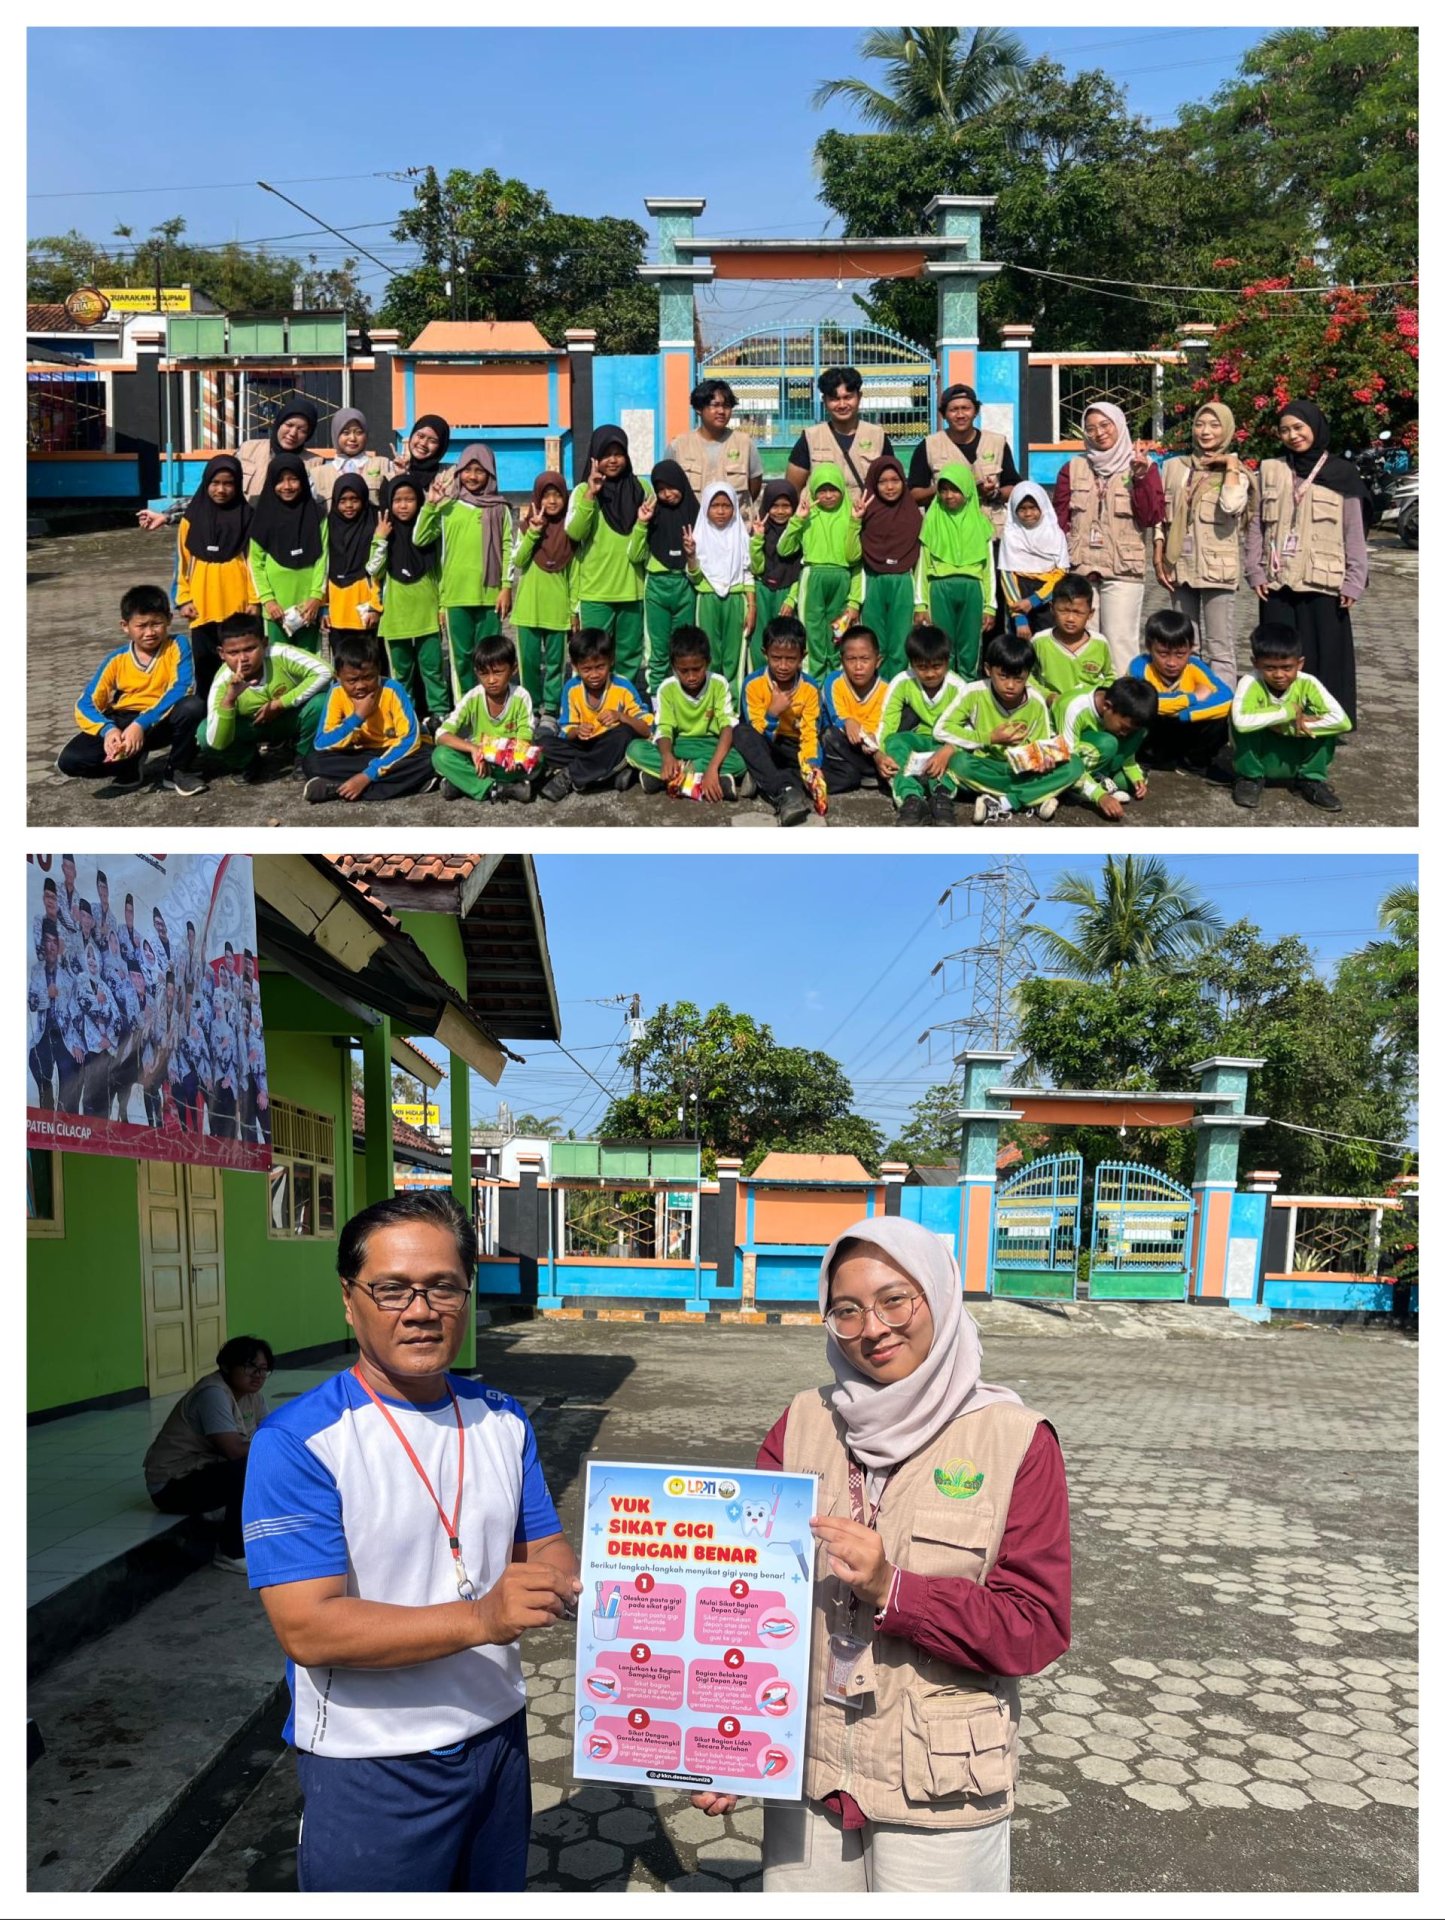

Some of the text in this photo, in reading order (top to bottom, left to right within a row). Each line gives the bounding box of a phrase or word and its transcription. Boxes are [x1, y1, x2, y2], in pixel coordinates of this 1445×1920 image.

[56, 1124, 92, 1138] CILACAP
[611, 1498, 650, 1513] YUK
[609, 1519, 714, 1539] SIKAT GIGI
[608, 1541, 757, 1564] DENGAN BENAR
[590, 1562, 786, 1580] Berikut langkah-langkah menyikat gigi yang benar!
[641, 1578, 648, 1588] 1
[735, 1584, 744, 1594] 2
[636, 1648, 645, 1658] 3
[729, 1654, 739, 1664] 4
[618, 1664, 648, 1672] Lanjutkan
[628, 1671, 656, 1679] Samping
[719, 1672, 748, 1680] Belakang
[634, 1714, 642, 1724] 5
[724, 1721, 734, 1732] 6
[644, 1738, 680, 1746] Mencungkil
